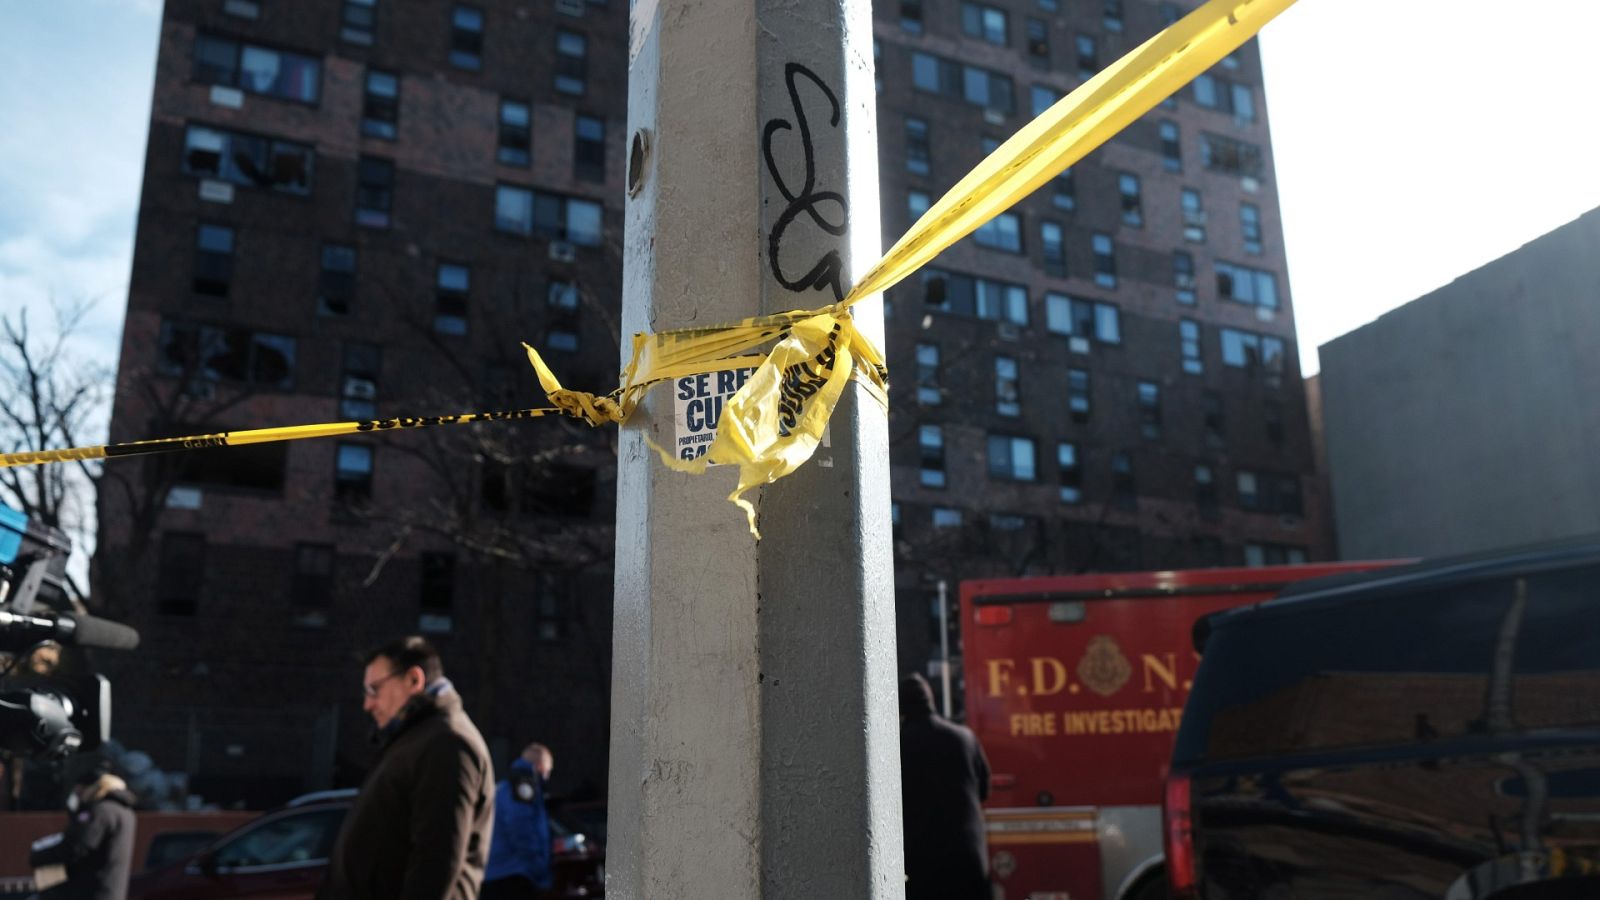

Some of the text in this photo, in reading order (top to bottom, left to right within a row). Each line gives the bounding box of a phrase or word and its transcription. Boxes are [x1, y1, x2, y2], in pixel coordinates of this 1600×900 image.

[678, 366, 758, 400] SE RE
[686, 394, 735, 432] CU
[985, 652, 1202, 698] F.D. N.
[1010, 713, 1057, 736] FIRE
